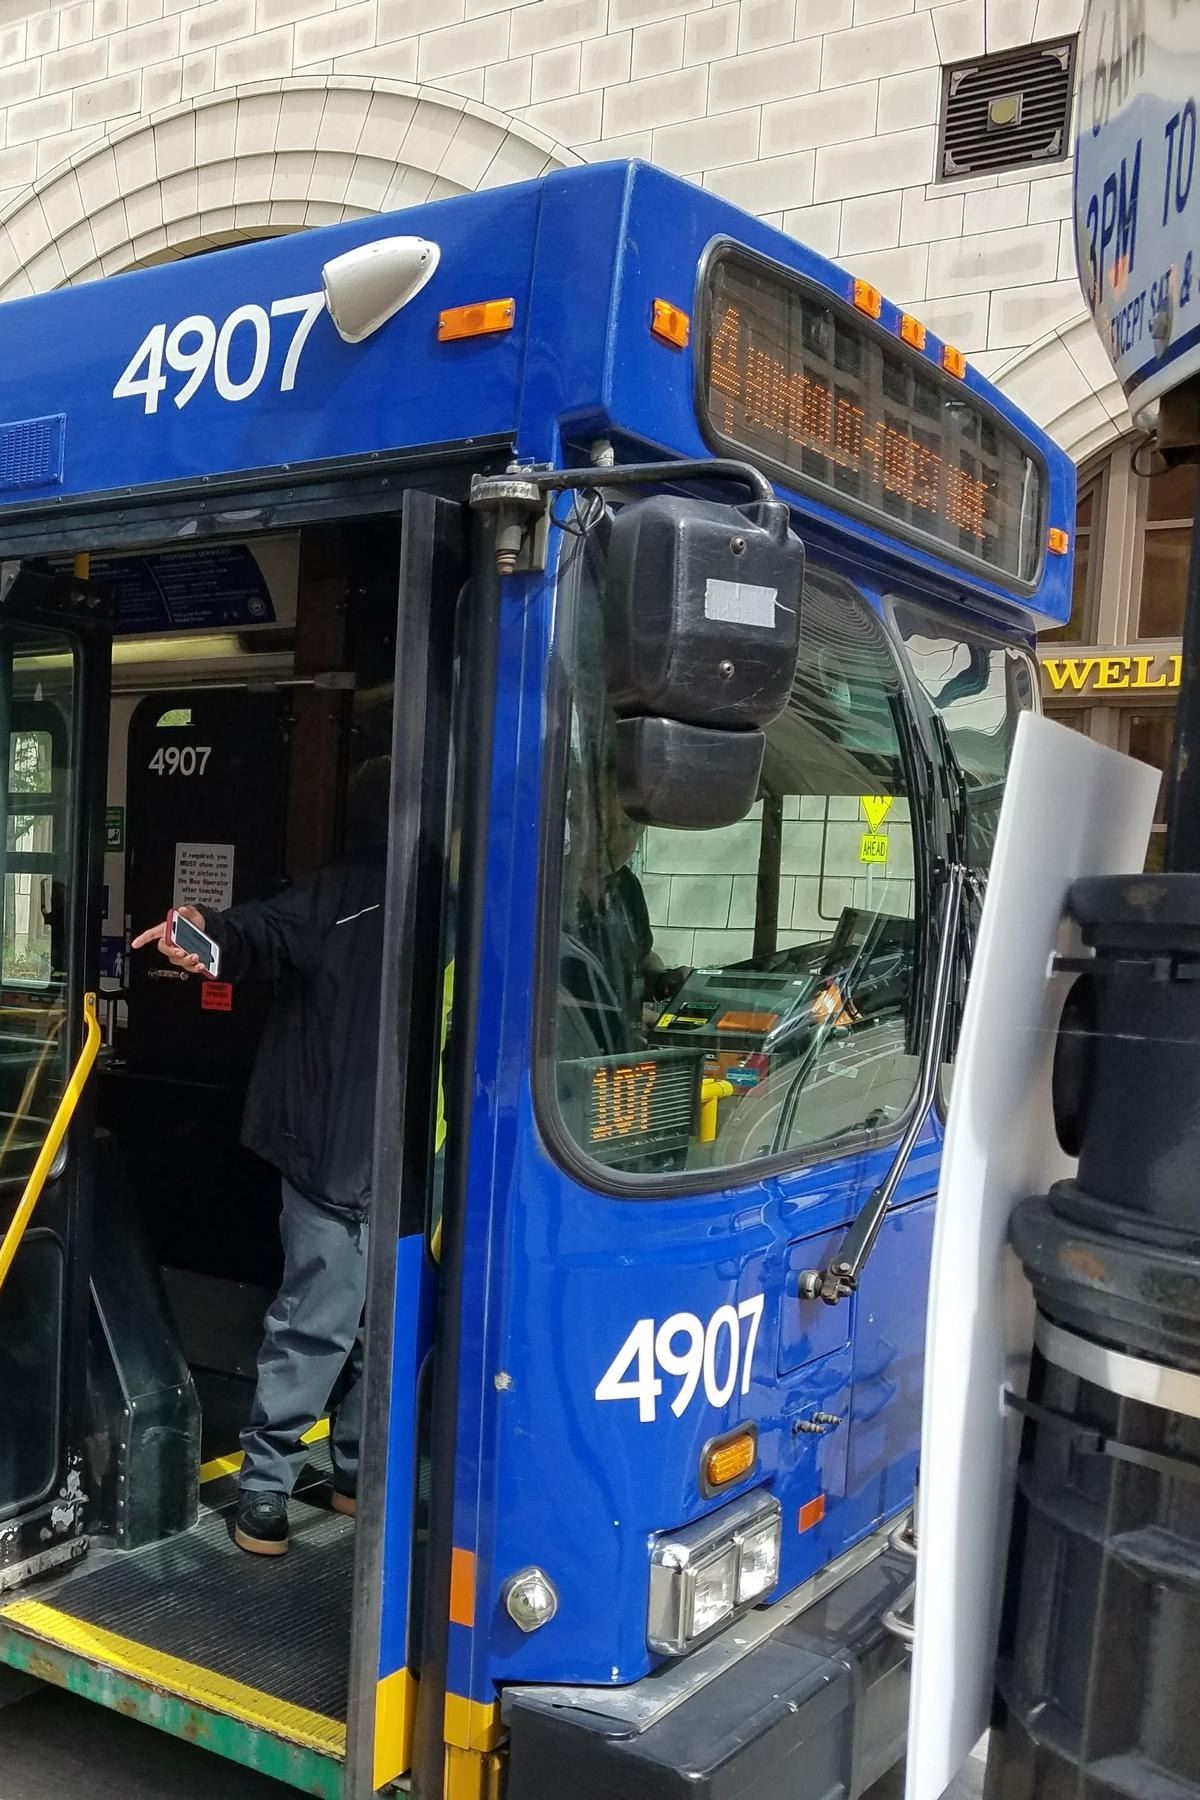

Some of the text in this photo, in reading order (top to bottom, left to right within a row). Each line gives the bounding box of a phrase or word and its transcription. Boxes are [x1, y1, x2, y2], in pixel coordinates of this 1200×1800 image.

[1086, 97, 1196, 317] 3PM TO
[113, 290, 327, 415] 4907
[1111, 290, 1146, 364] EXCEPT
[148, 746, 212, 776] 4907
[202, 878, 229, 887] Operator
[863, 841, 886, 857] AHEAD
[595, 1293, 765, 1423] 4907
